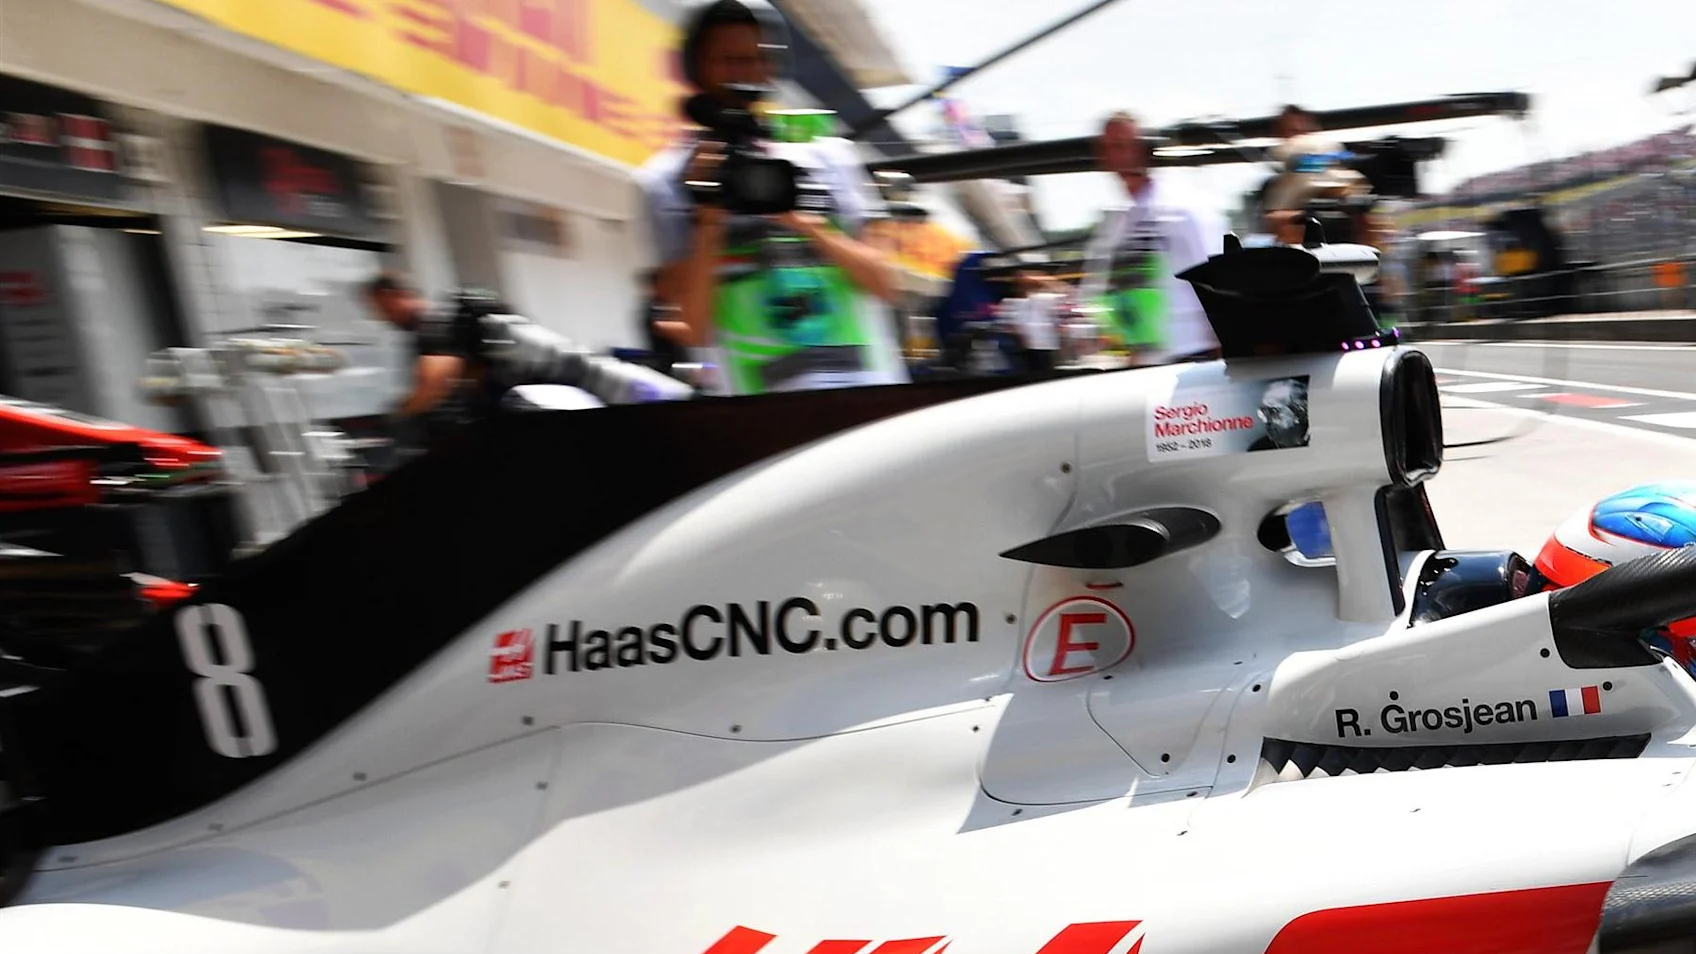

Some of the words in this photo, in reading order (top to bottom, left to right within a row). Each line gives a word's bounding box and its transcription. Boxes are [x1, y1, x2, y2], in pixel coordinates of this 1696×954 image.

[1155, 402, 1208, 421] Sergio
[1155, 416, 1253, 438] Marchionne
[543, 596, 980, 676] HaasCNC.com
[1048, 613, 1107, 677] E
[174, 602, 280, 759] 8
[1334, 708, 1372, 738] R.
[1380, 697, 1538, 735] Grosjean
